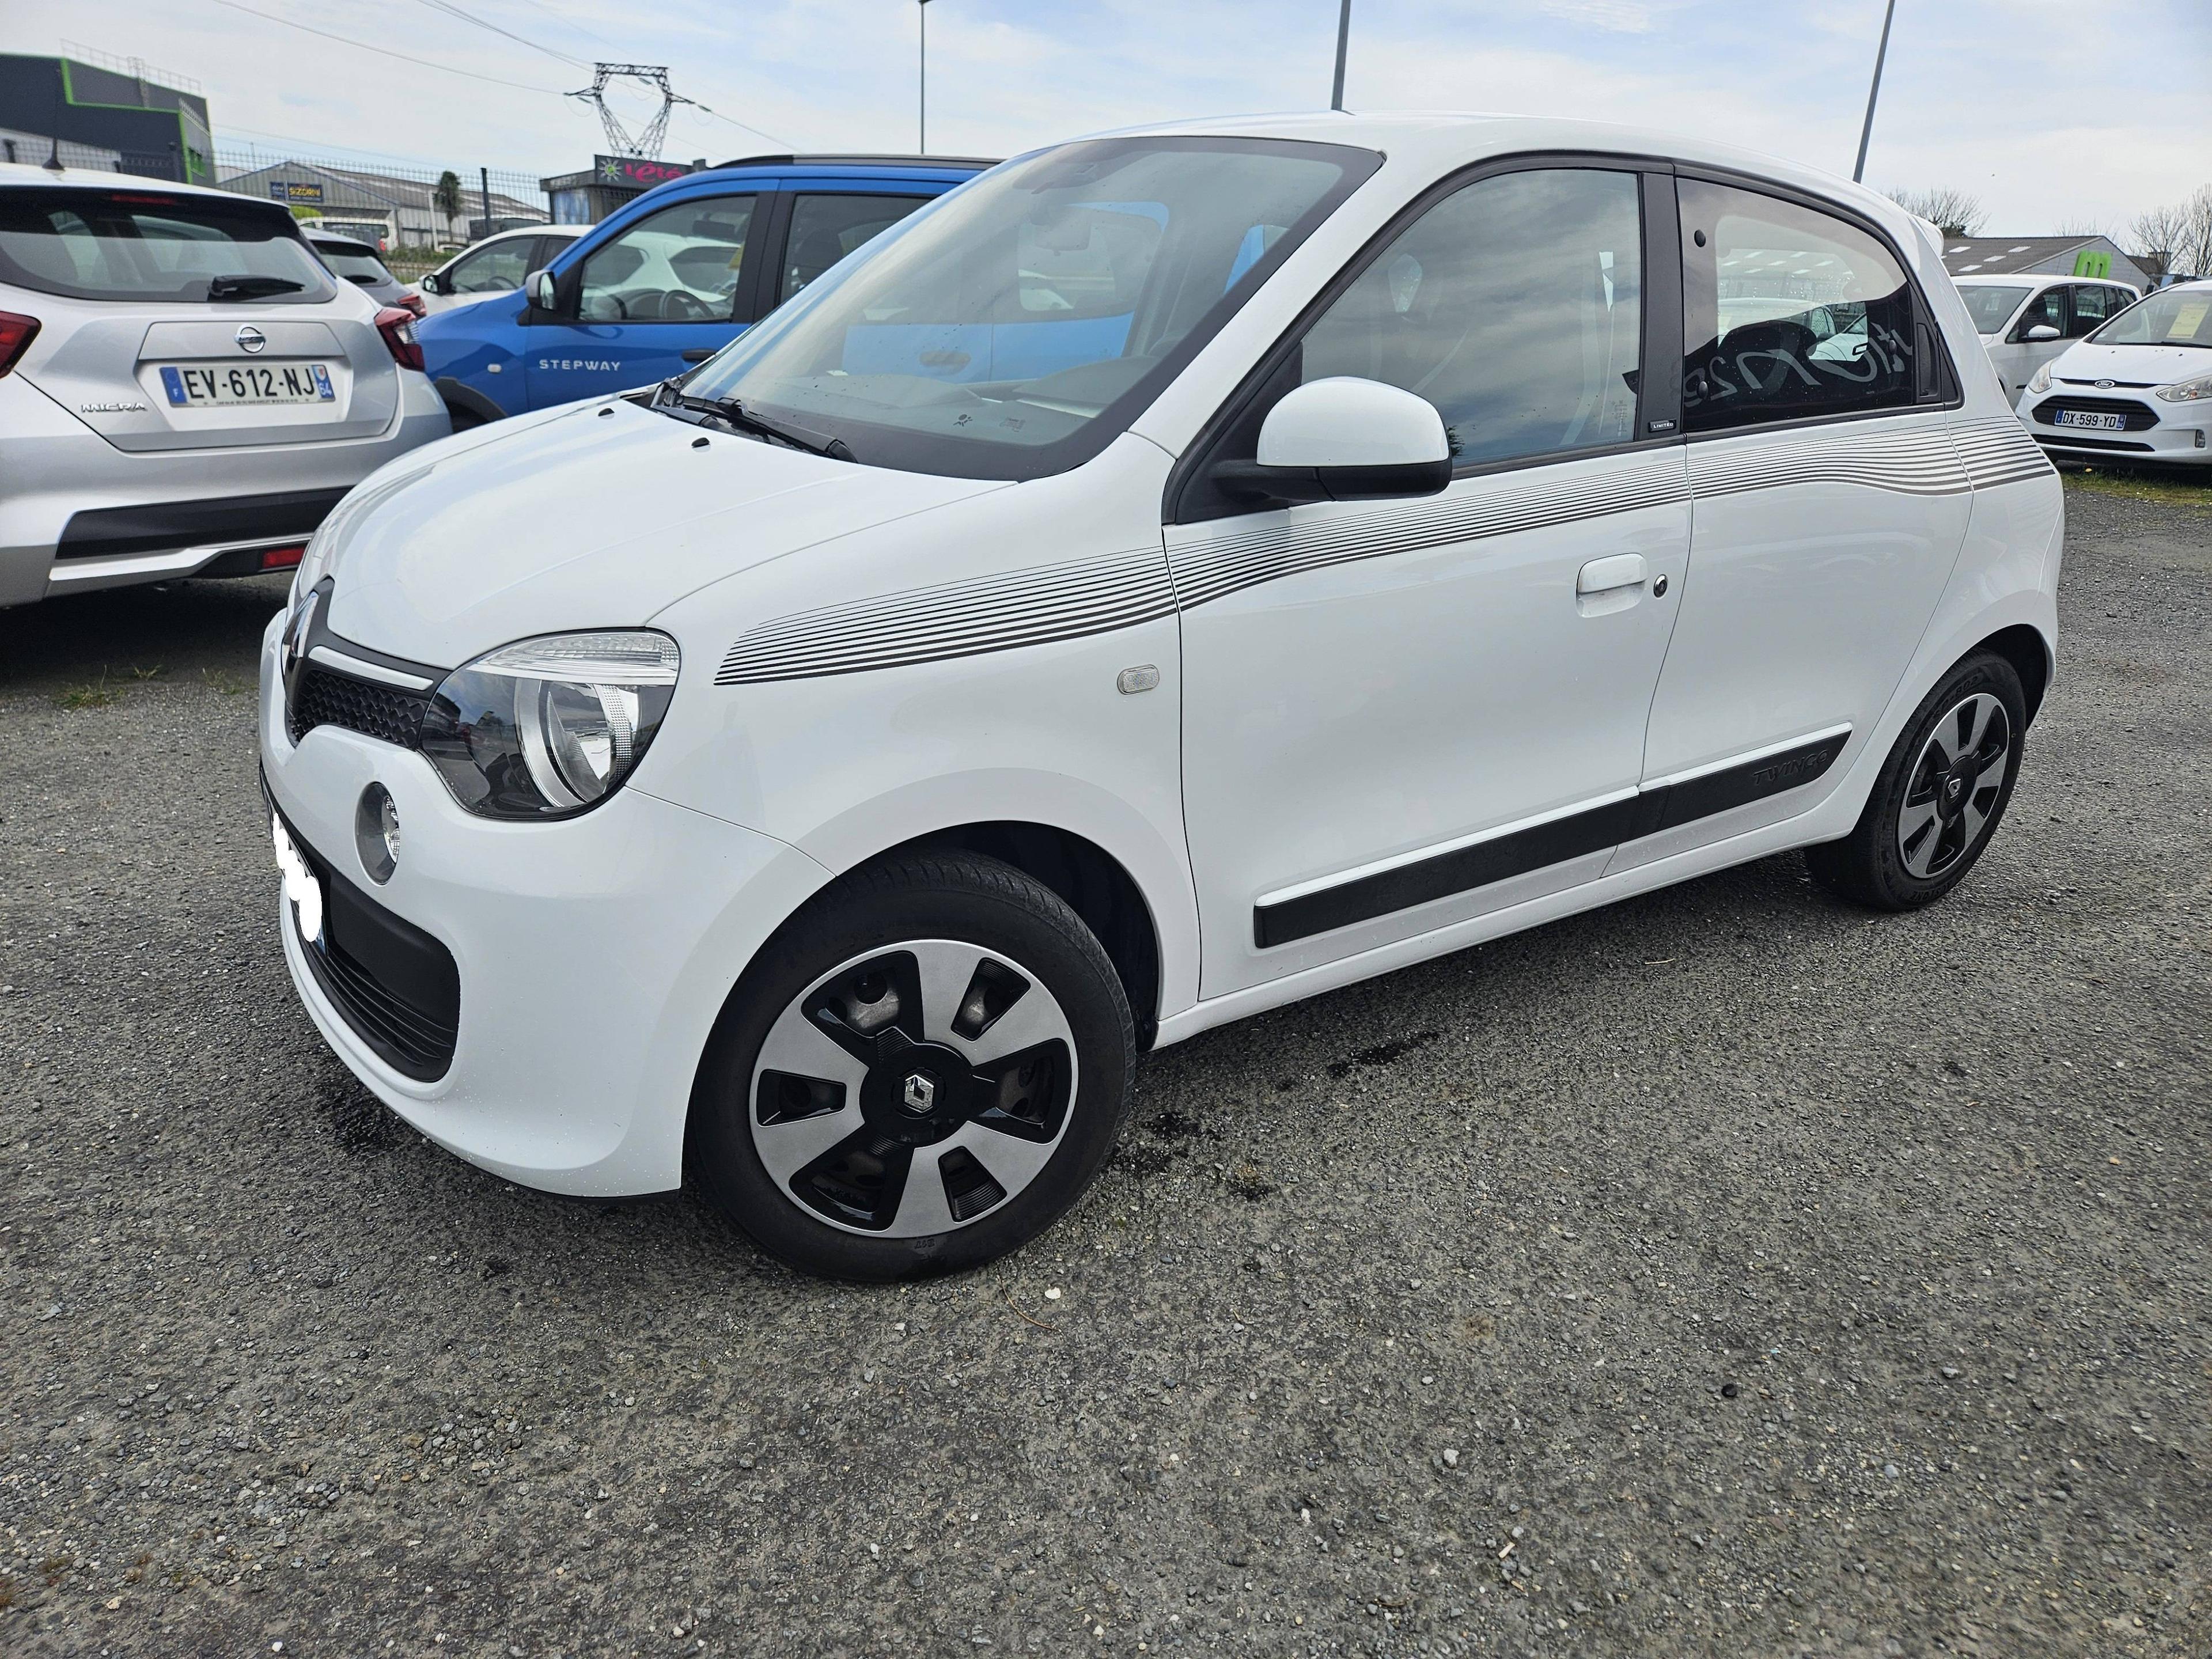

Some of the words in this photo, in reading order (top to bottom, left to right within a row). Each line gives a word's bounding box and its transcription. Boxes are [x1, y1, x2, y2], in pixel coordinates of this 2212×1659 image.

[539, 359, 620, 371] STEPWAY
[183, 369, 315, 398] EV-612-NJ
[81, 402, 147, 412] MICRA
[2062, 412, 2116, 427] DX-599-YD
[1753, 749, 1829, 786] TWINGO
